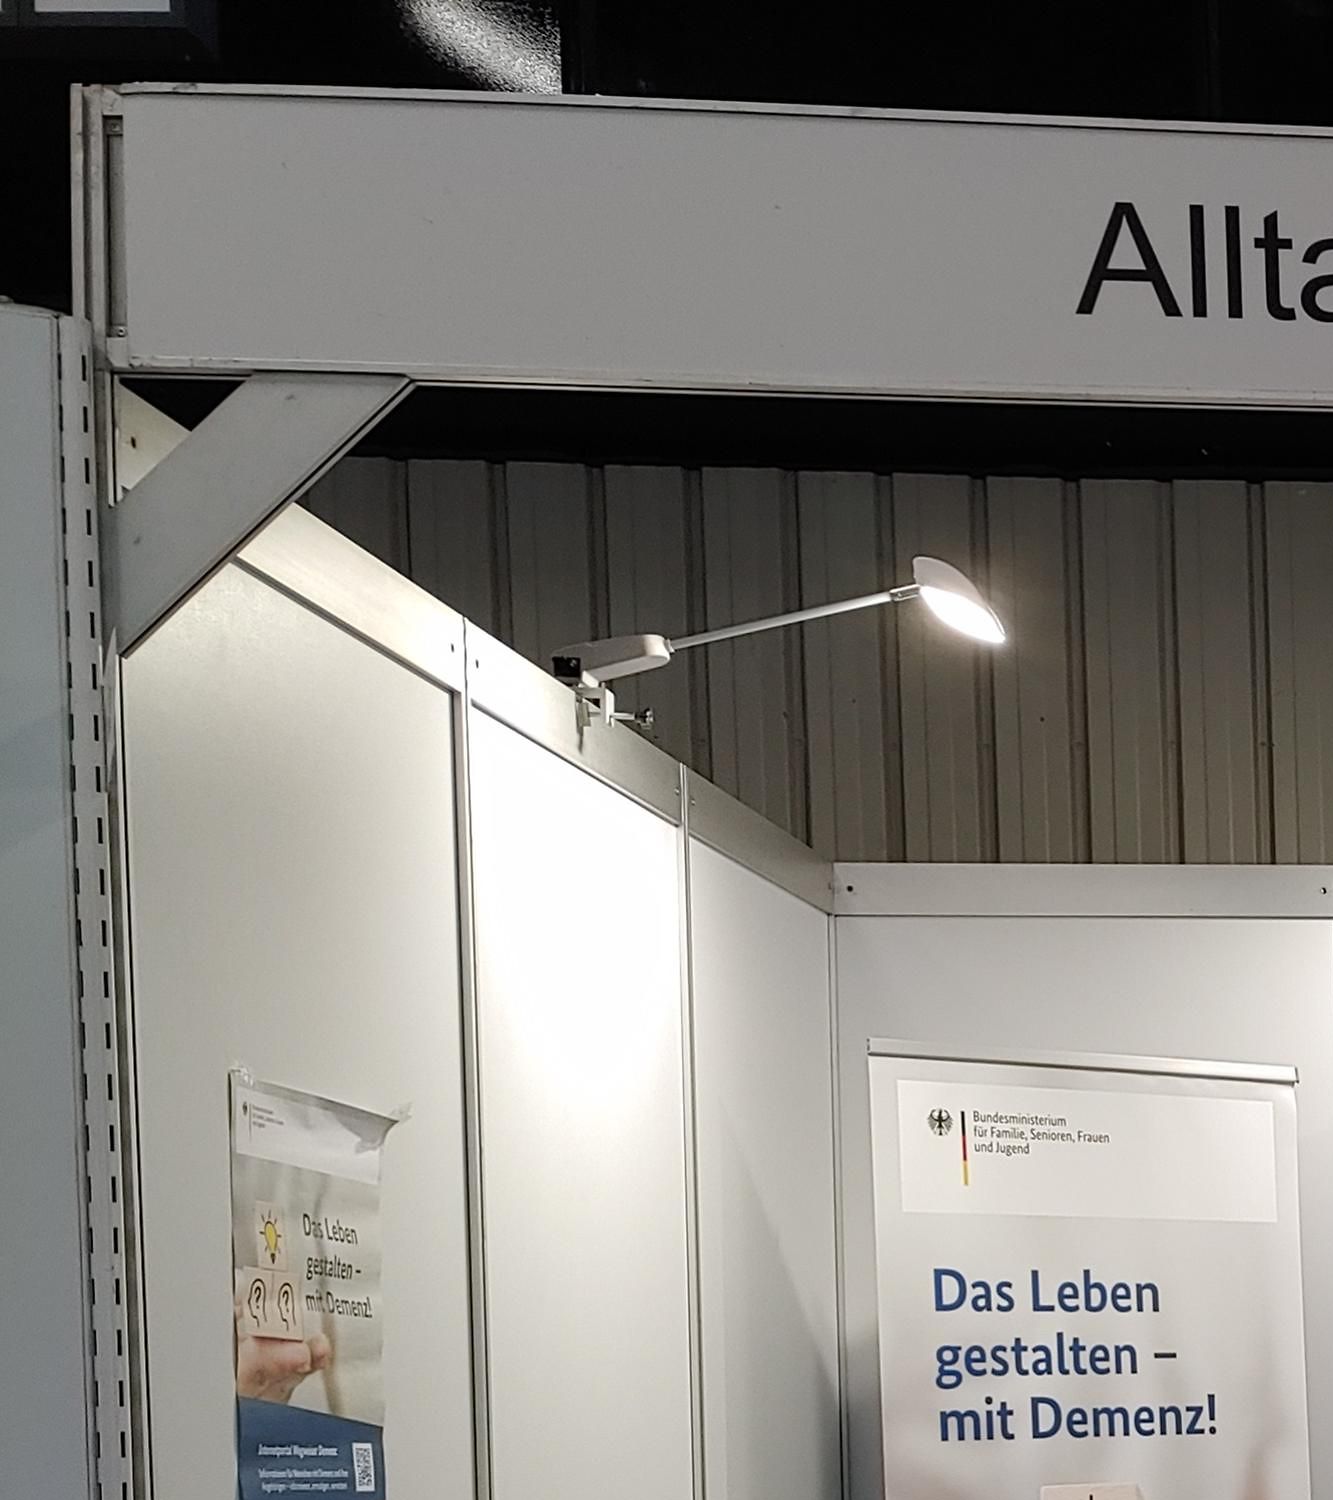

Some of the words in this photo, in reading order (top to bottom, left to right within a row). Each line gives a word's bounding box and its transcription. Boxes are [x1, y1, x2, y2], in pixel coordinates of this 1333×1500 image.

[973, 1111, 1066, 1127] Bundesministerium
[974, 1126, 987, 1138] für
[990, 1127, 1028, 1141] Familie,
[1030, 1128, 1075, 1143] Senioren,
[1078, 1130, 1110, 1143] Frauen
[974, 1141, 993, 1152] und
[996, 1142, 1030, 1156] Jugend
[303, 1213, 323, 1239] Das
[325, 1216, 358, 1245] Leben
[305, 1255, 354, 1281] gestalten
[305, 1292, 325, 1313] mit
[933, 1268, 1015, 1312] Das
[1030, 1269, 1160, 1313] Leben
[935, 1332, 1138, 1389] gestalten
[939, 1396, 1015, 1442] mit
[1030, 1394, 1217, 1440] Demenz!
